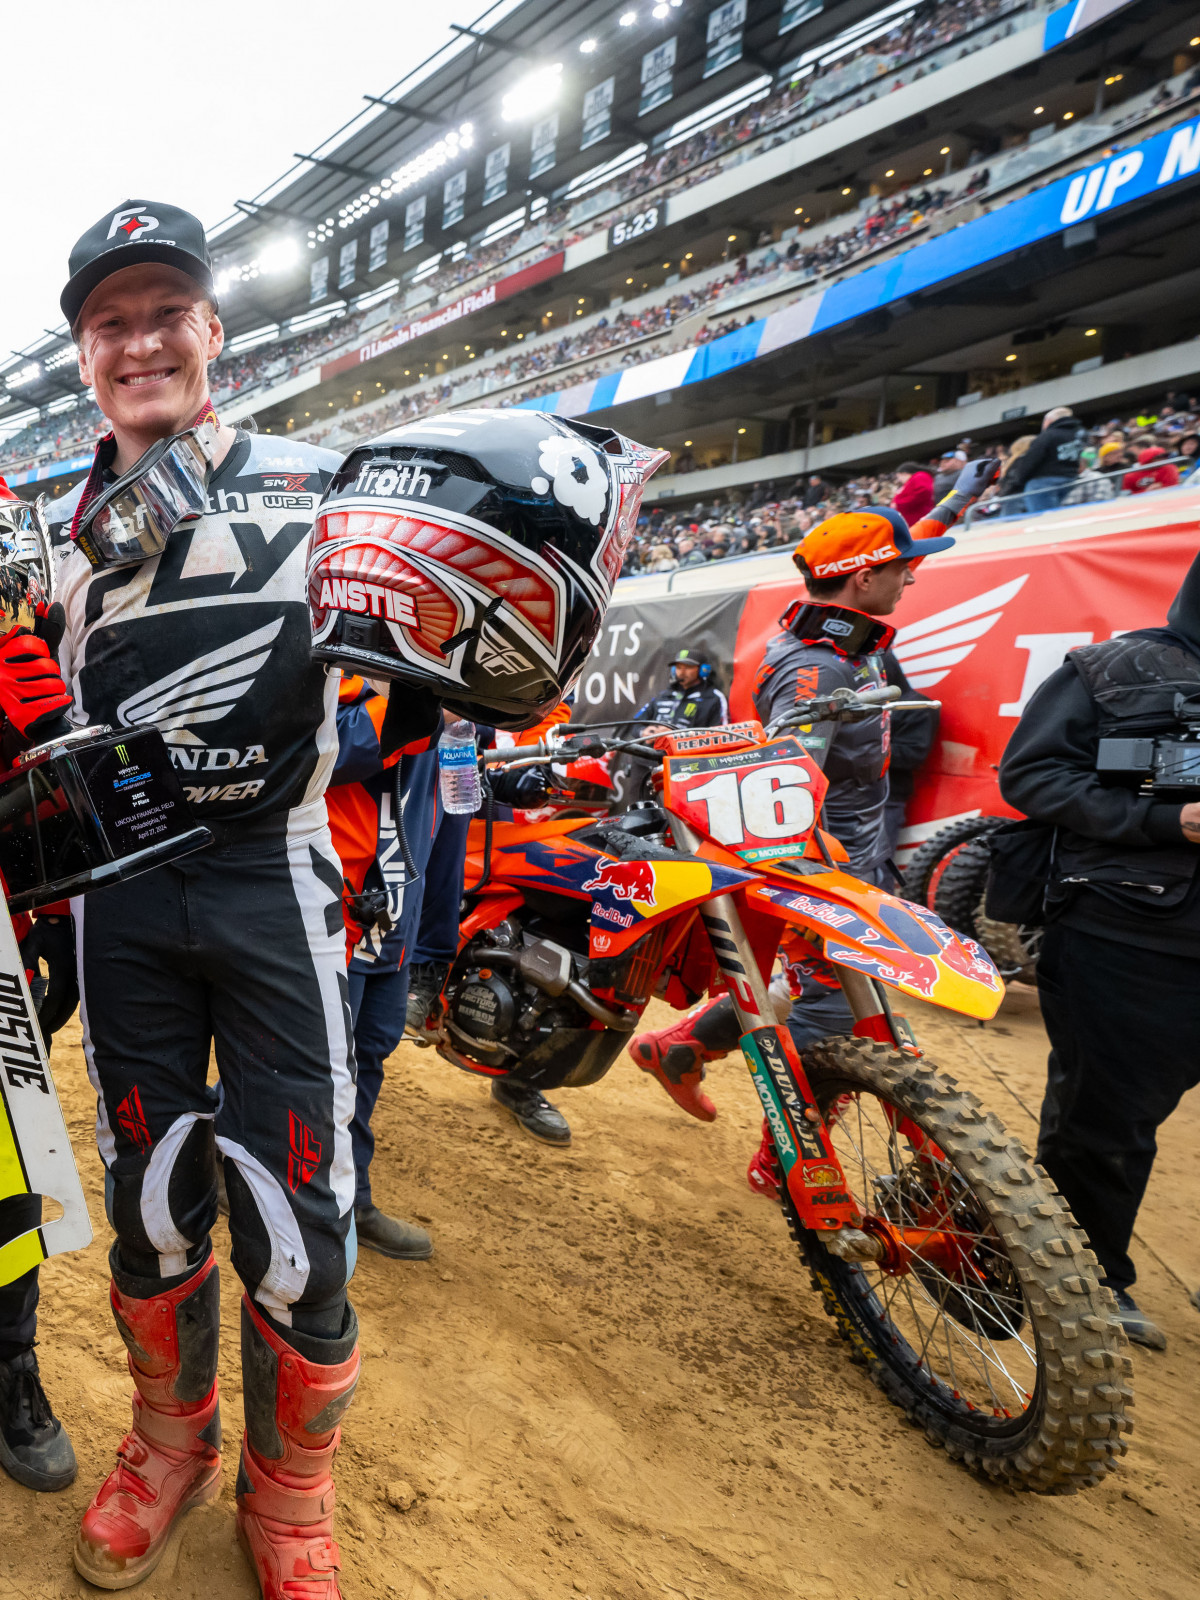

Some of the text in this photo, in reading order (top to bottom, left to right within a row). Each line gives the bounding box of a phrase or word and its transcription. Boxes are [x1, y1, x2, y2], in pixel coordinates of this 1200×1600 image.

[1060, 151, 1144, 224] UP
[613, 208, 658, 245] 5:23
[371, 286, 496, 358] Lincoln Financial Field
[263, 477, 307, 491] SMX
[355, 464, 432, 497] froth
[264, 496, 312, 509] WPS
[80, 536, 99, 565] OAKLEY
[84, 523, 316, 628] FLY
[319, 577, 421, 631] ANSTIE
[677, 731, 759, 750] RENTHAL
[168, 745, 269, 770] NDA
[443, 751, 473, 760] AQUAFINA
[720, 753, 761, 764] MONSTER
[115, 801, 175, 827] LINCOLN FINANCIAL FIELD
[687, 764, 815, 846] 16
[138, 831, 149, 840] April
[156, 824, 167, 833] 2024
[758, 845, 802, 858] MOTOREX
[753, 1075, 795, 1157] MOTOREX
[812, 1191, 849, 1205] KTM
